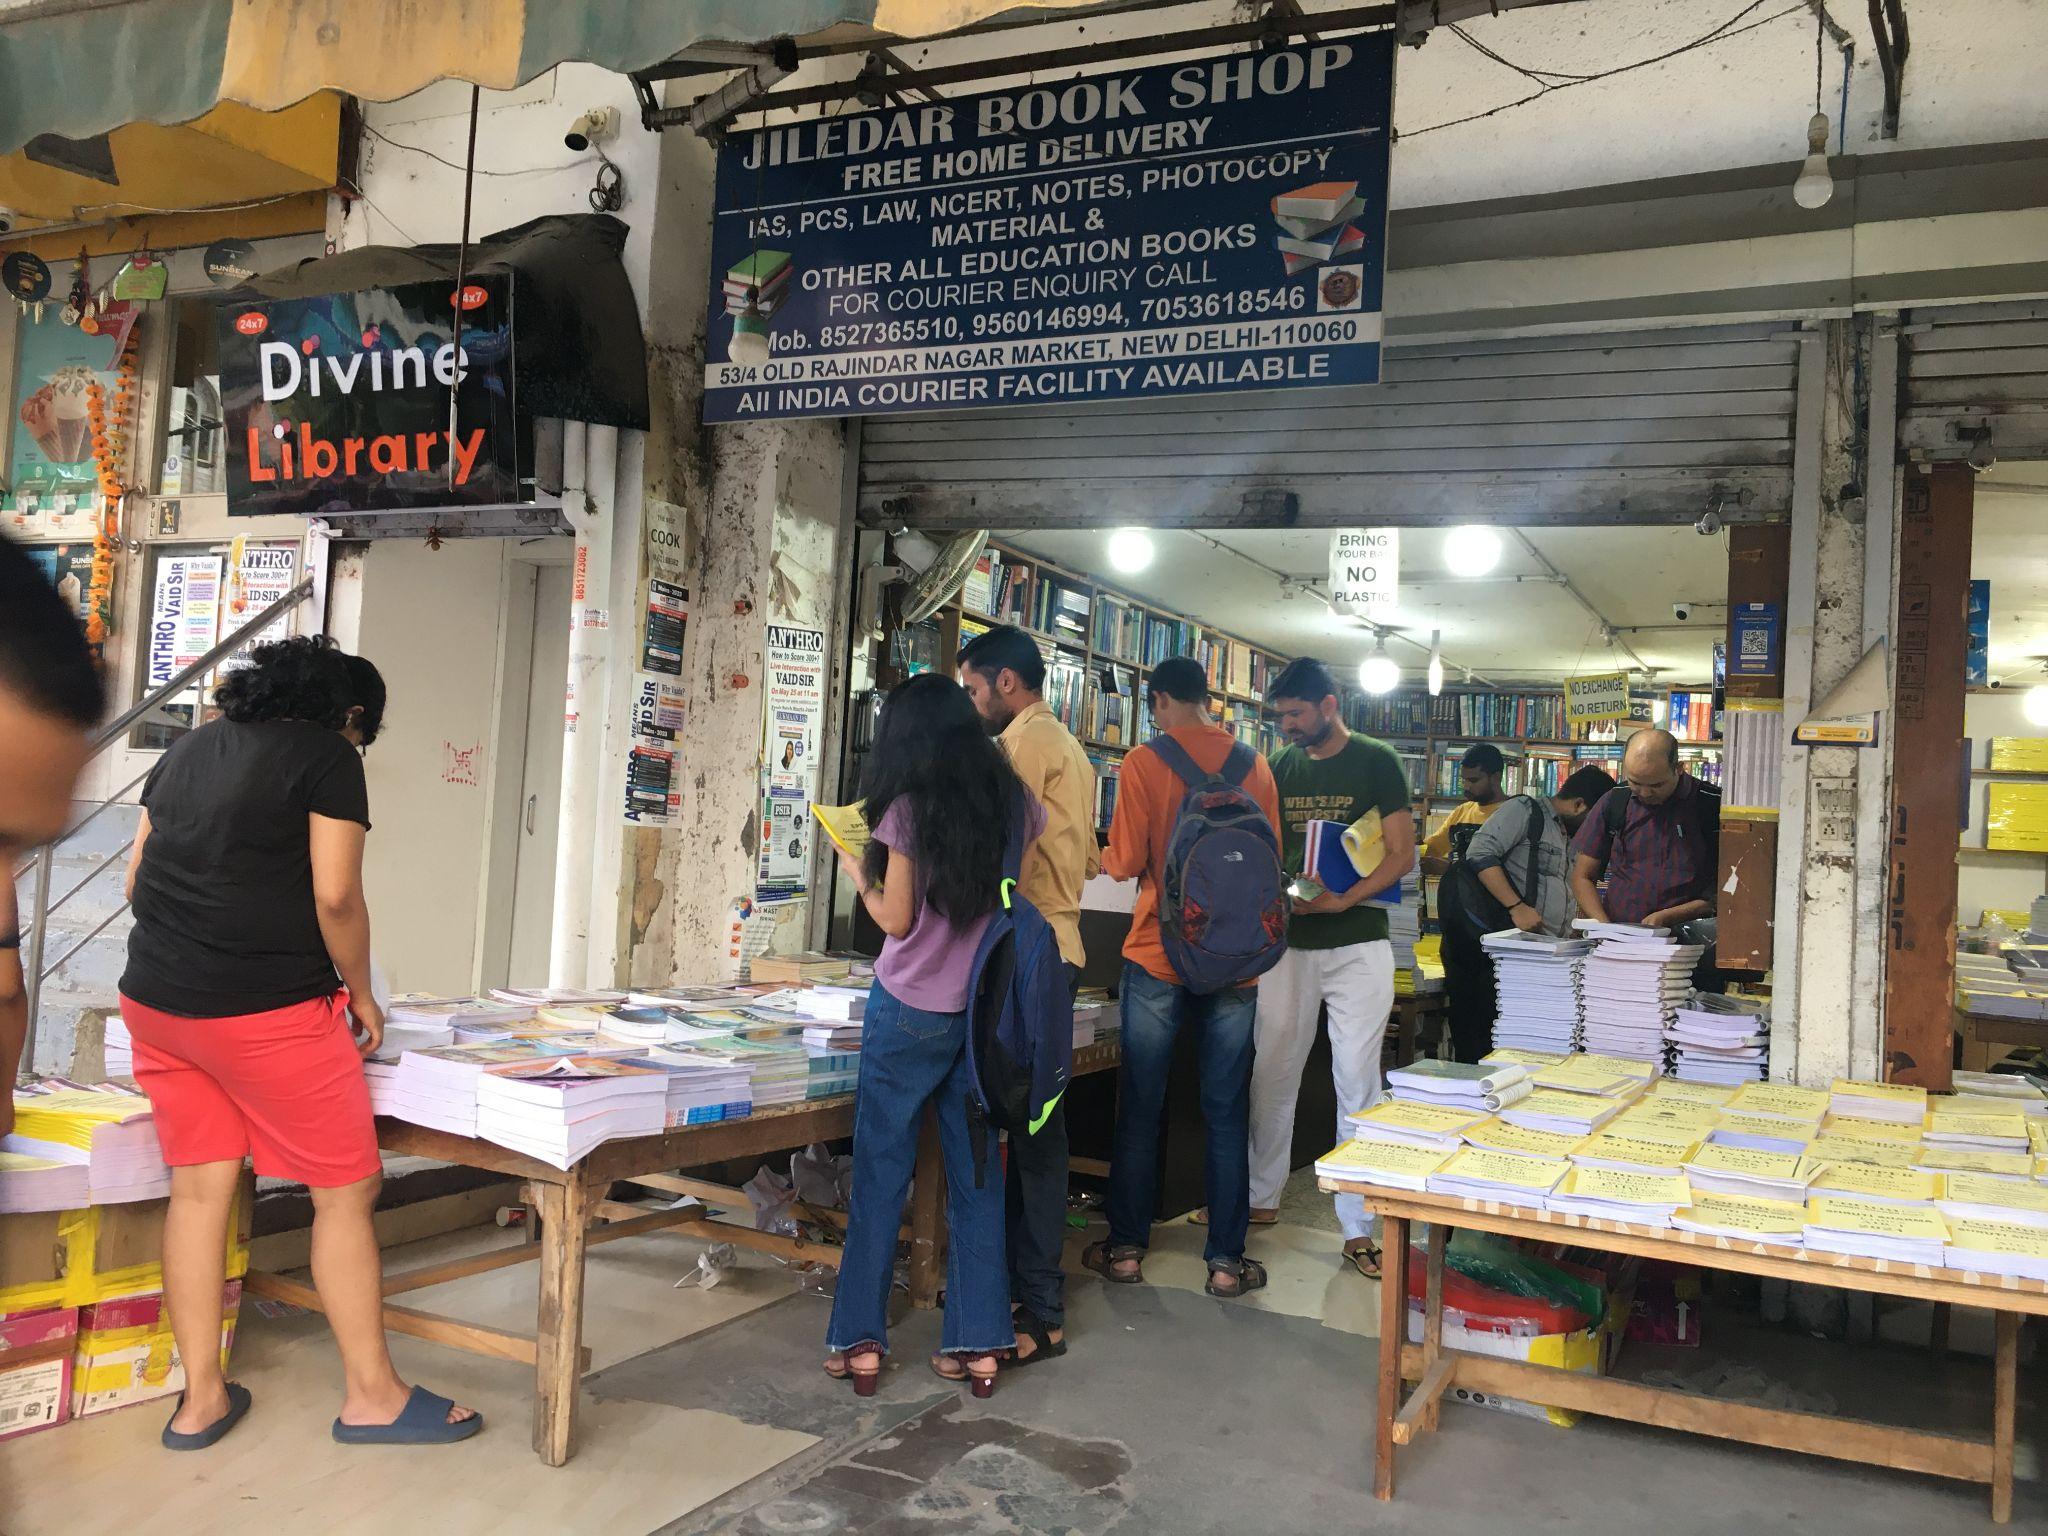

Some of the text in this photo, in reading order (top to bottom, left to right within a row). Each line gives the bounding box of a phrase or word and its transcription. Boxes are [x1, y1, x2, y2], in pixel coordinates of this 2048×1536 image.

[743, 44, 1353, 170] JILEDAR BOOK SHOP
[844, 116, 1213, 191] FREE HOME DELIVERY
[749, 147, 1334, 239] IAS, PCS, LAW, NCERT, NOTES, PHOTOCOPY
[932, 207, 1105, 248] MATERIAL &
[802, 223, 1257, 291] OTHER ALL EDUCATION BOOKS
[829, 259, 1217, 317] FOR COURIER ENQUIRY CALL
[239, 318, 264, 330] 24x7
[820, 316, 964, 348] 8527365510,
[973, 301, 1130, 336] 9560146994,
[1141, 285, 1305, 322] 7053618546
[720, 319, 1357, 385] 53/4 OLD RAJINDAR NAGAR MARKET, NEW DELHI-110060
[260, 330, 469, 401] Divine
[779, 387, 850, 411] INDIA
[858, 376, 989, 405] COURIER
[998, 367, 1135, 399] FACILITY
[1141, 353, 1330, 388] AVAILABLE
[248, 422, 486, 486] Library
[651, 529, 680, 549] COOK
[1340, 535, 1388, 547] BRING
[242, 551, 292, 569] NTHRO
[1337, 550, 1367, 558] YOUR
[575, 546, 587, 600] 8851723082
[1347, 567, 1376, 582] NO
[157, 582, 165, 612] MEANS
[262, 591, 280, 601] SIR
[153, 562, 184, 682] ANTHRO VAID SIR
[769, 627, 822, 652] ANTHRO
[771, 651, 783, 659] How
[790, 653, 804, 661] Score
[782, 664, 809, 672] Interaction
[776, 672, 814, 686] VAID SIR
[779, 688, 789, 696] May
[1569, 677, 1623, 696] NO EXCHANGE
[640, 681, 656, 707] SIR
[1571, 700, 1626, 715] NO RETURN
